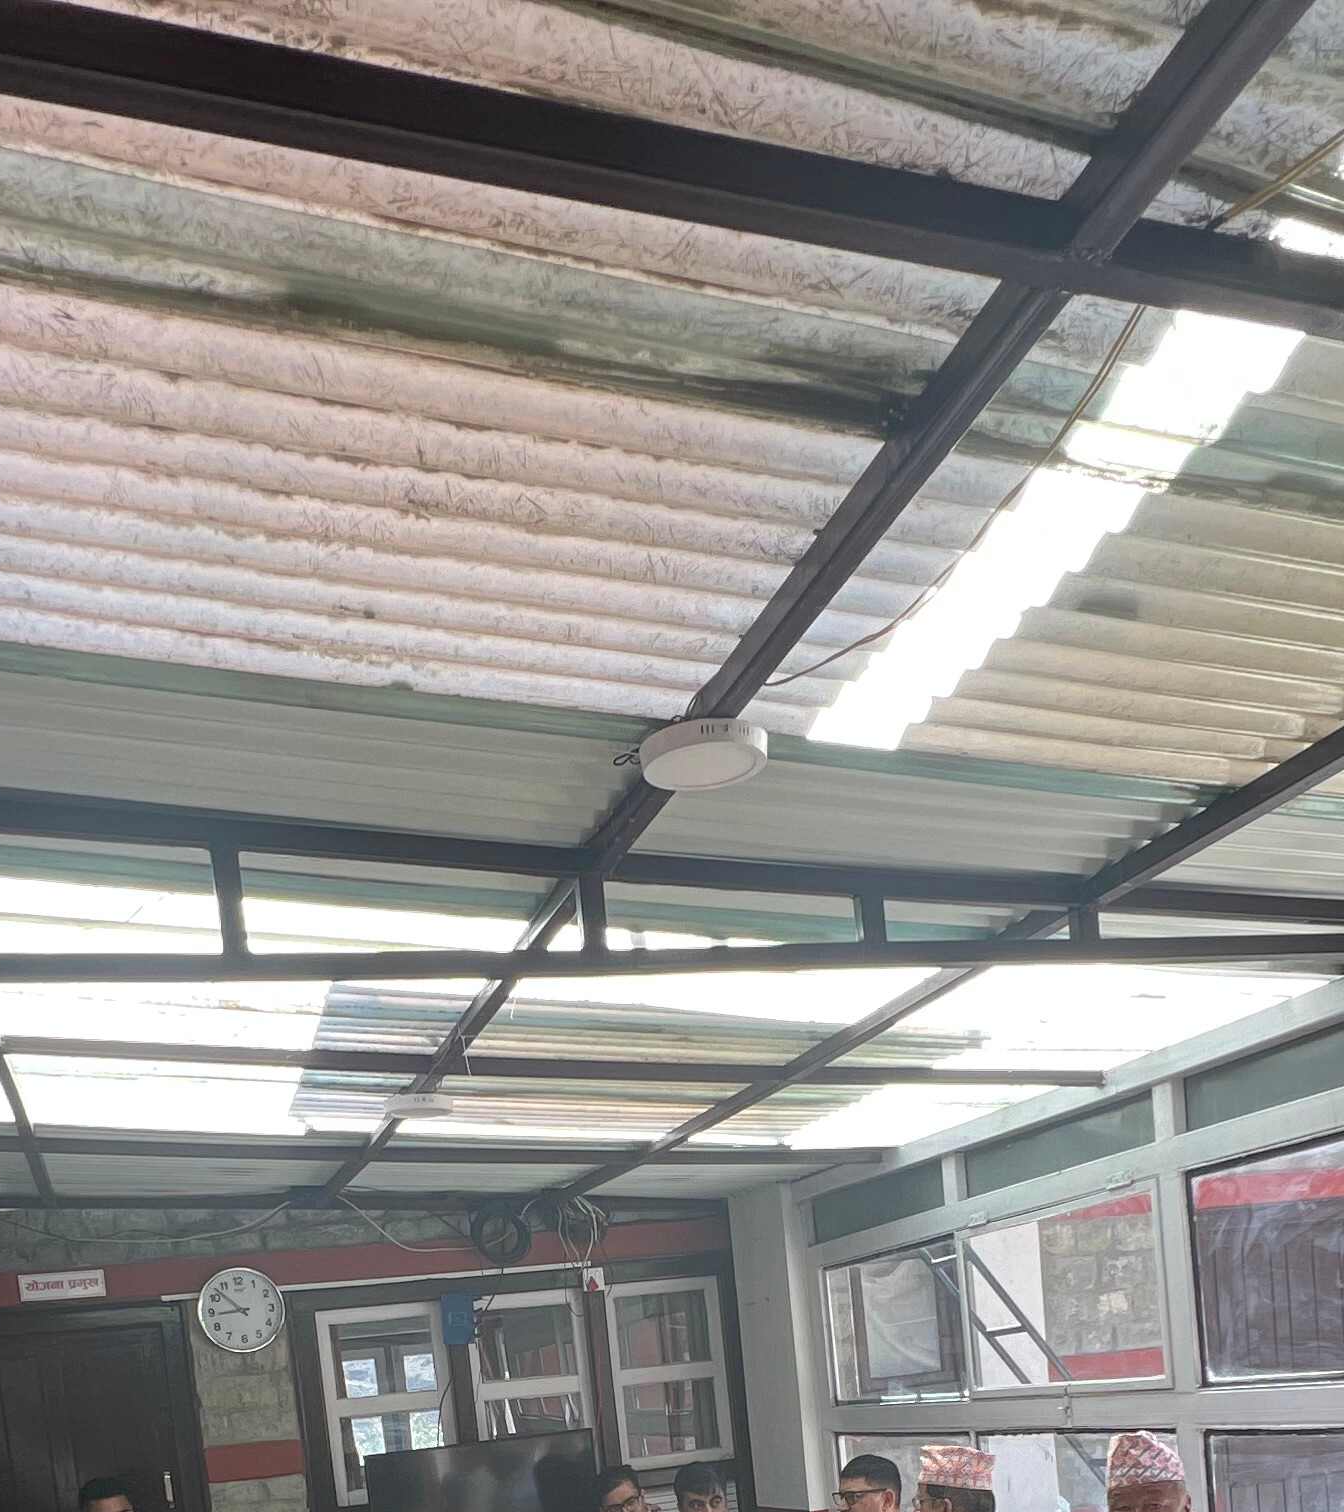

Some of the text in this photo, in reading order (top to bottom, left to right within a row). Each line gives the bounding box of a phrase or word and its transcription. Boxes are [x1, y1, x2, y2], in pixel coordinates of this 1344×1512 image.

[233, 1276, 243, 1286] 12
[220, 1282, 228, 1290] 11
[209, 1293, 221, 1303] 10
[262, 1289, 270, 1298] 2
[268, 1303, 275, 1312] 3
[208, 1308, 215, 1317] 9
[214, 1322, 221, 1331] 8
[265, 1318, 272, 1327] 4
[225, 1331, 232, 1341] 7
[241, 1334, 248, 1343] 6
[256, 1329, 263, 1339] 5
